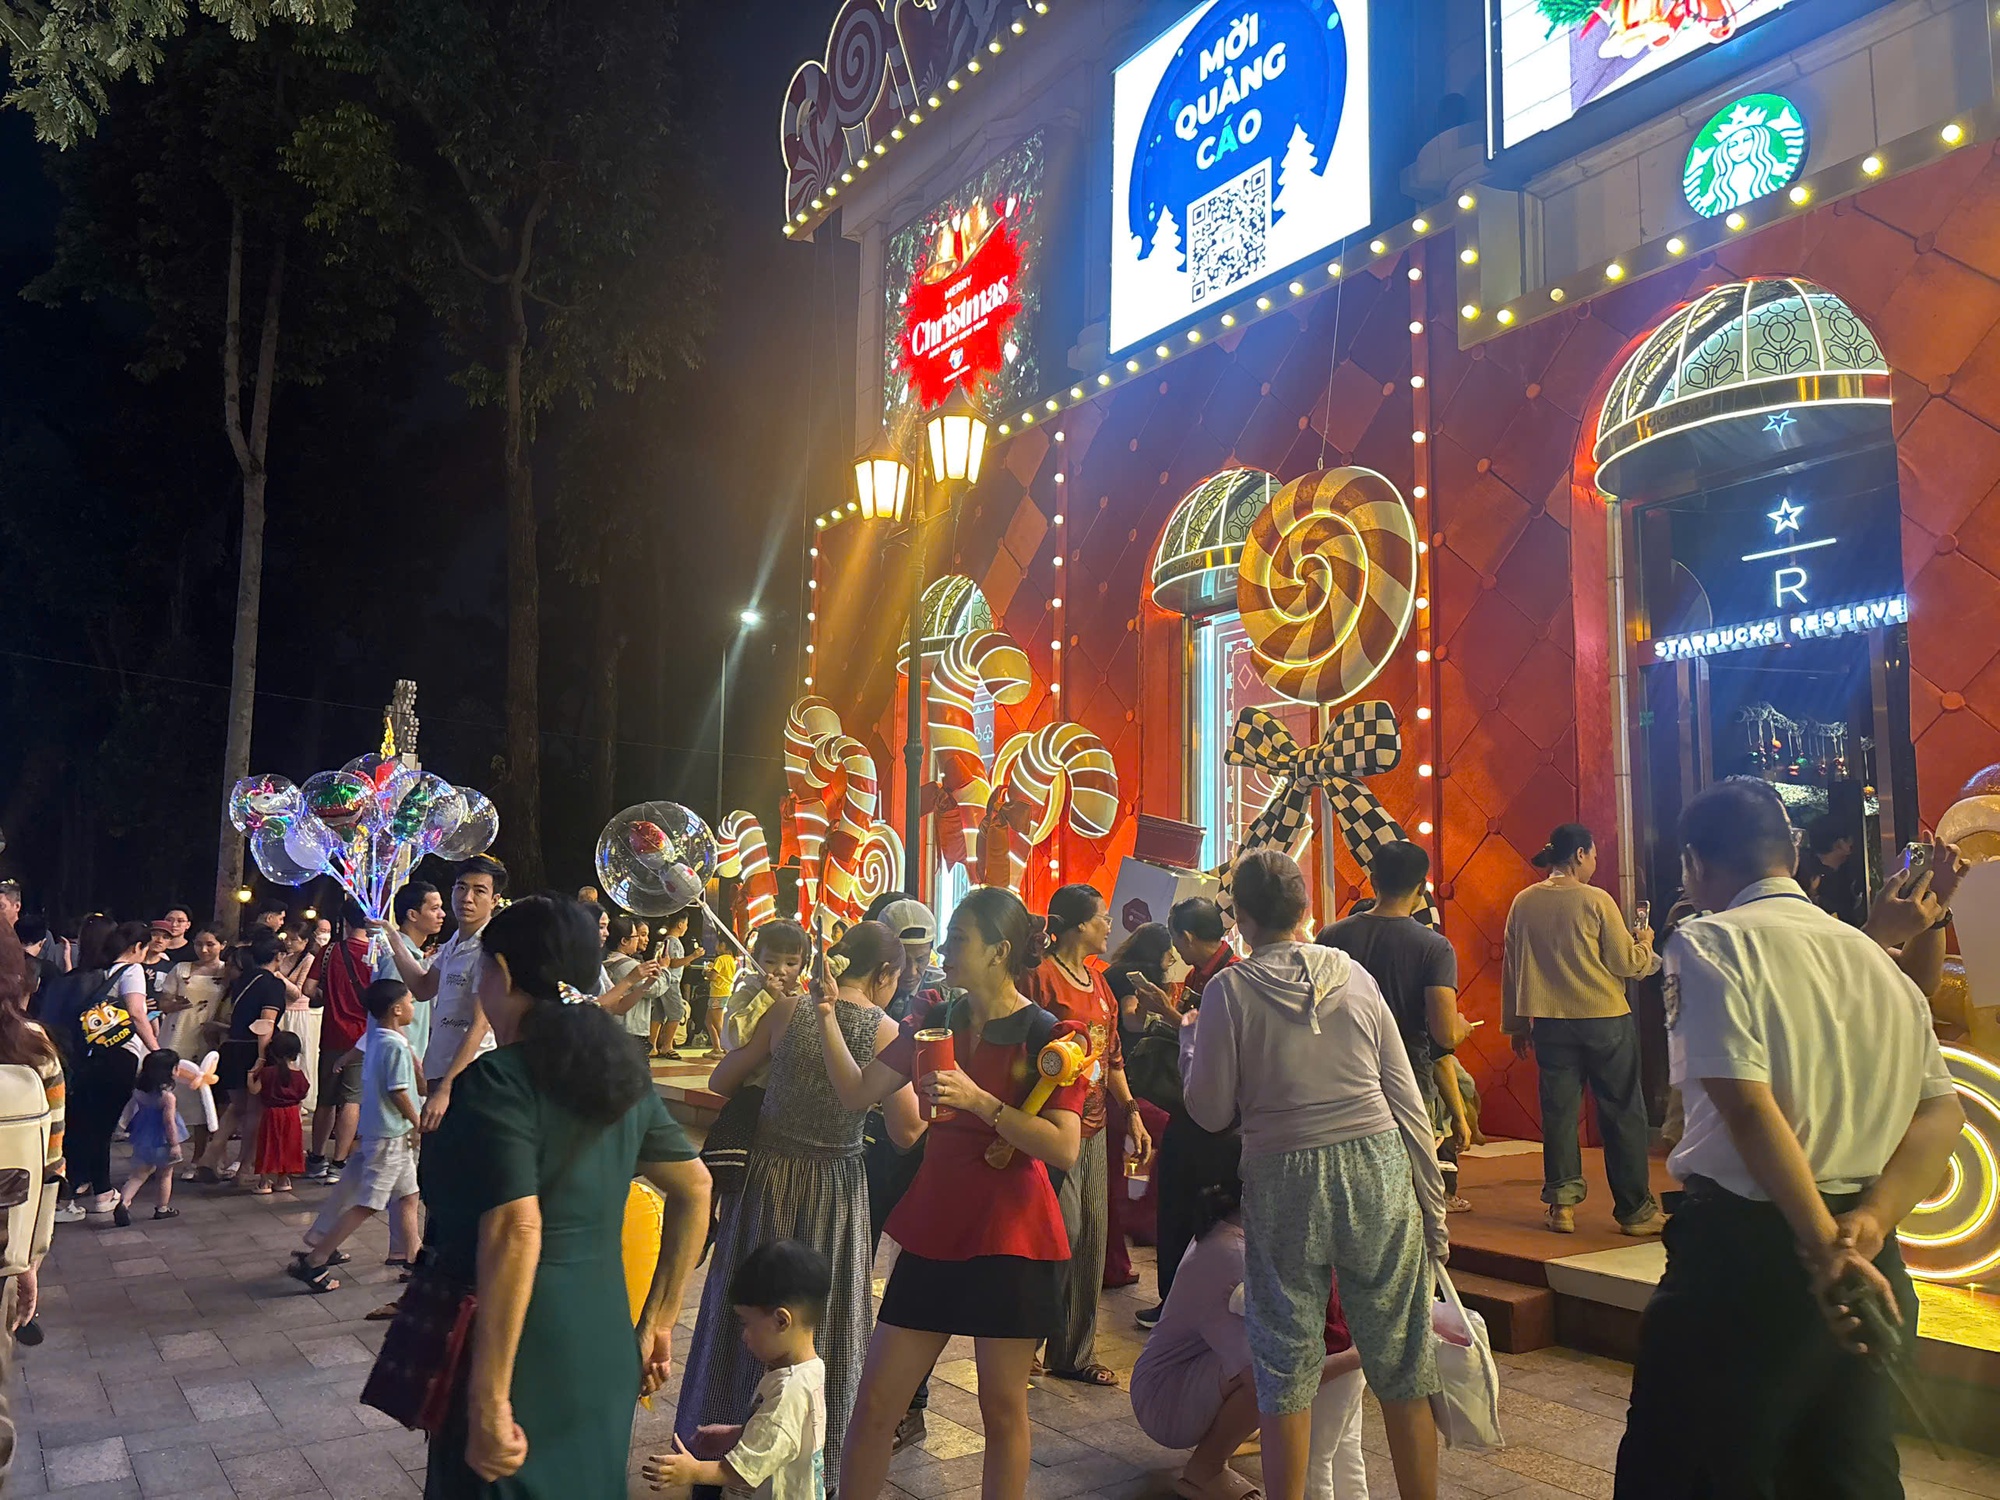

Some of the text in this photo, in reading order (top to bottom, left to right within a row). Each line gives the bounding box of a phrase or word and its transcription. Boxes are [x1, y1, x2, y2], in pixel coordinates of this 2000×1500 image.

[1199, 12, 1259, 83] MỜI
[1174, 42, 1287, 142] QUẢNG
[1196, 108, 1263, 171] CÁO
[911, 275, 1009, 357] Christmas
[944, 274, 972, 301] MERRY
[1775, 566, 1808, 609] R
[1653, 598, 1908, 658] STARBUCKS RESERVE
